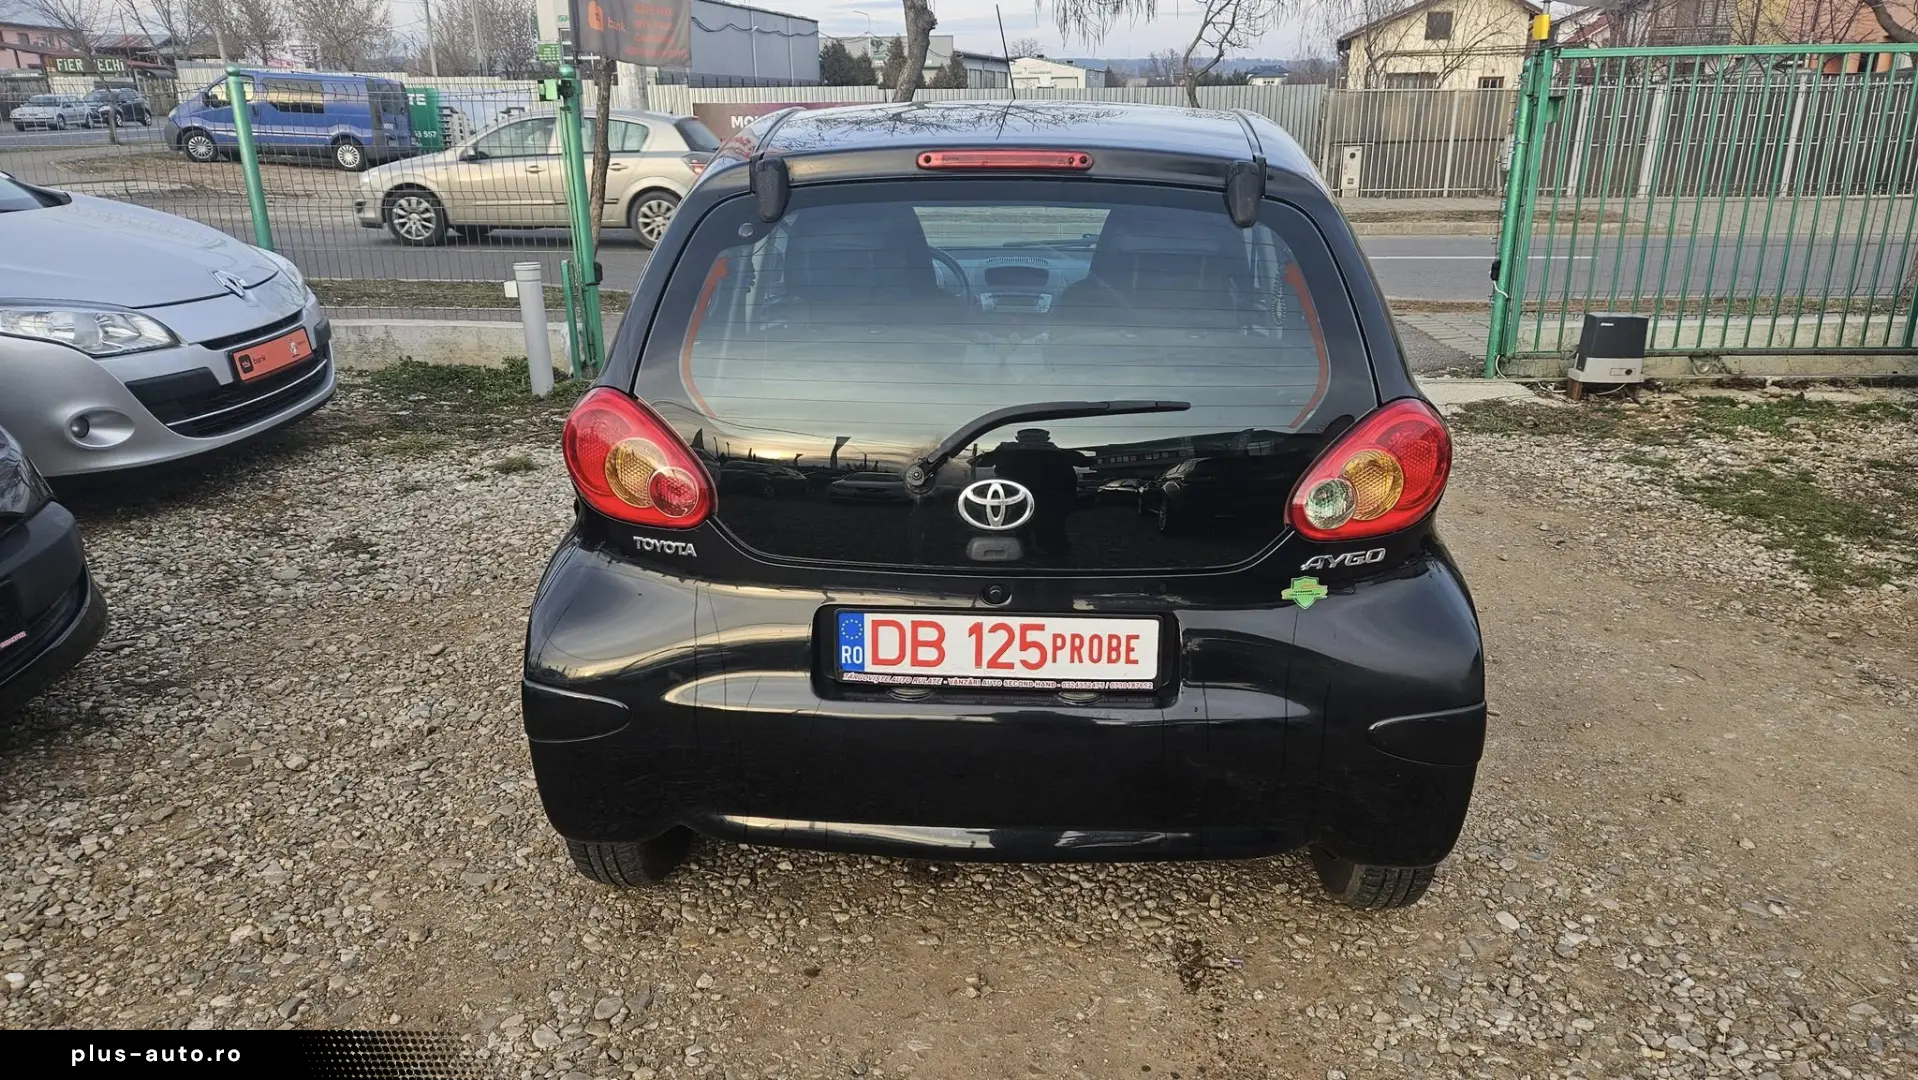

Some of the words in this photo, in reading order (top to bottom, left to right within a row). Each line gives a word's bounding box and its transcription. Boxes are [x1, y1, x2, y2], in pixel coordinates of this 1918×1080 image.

[633, 536, 697, 557] TOYOTA
[1300, 548, 1386, 571] AYGO
[841, 646, 863, 664] RO
[871, 619, 946, 668] DB
[968, 621, 1048, 671] 125
[1051, 633, 1140, 665] PROBE
[981, 679, 1002, 687] AUTO
[1003, 679, 1035, 687] SECOND
